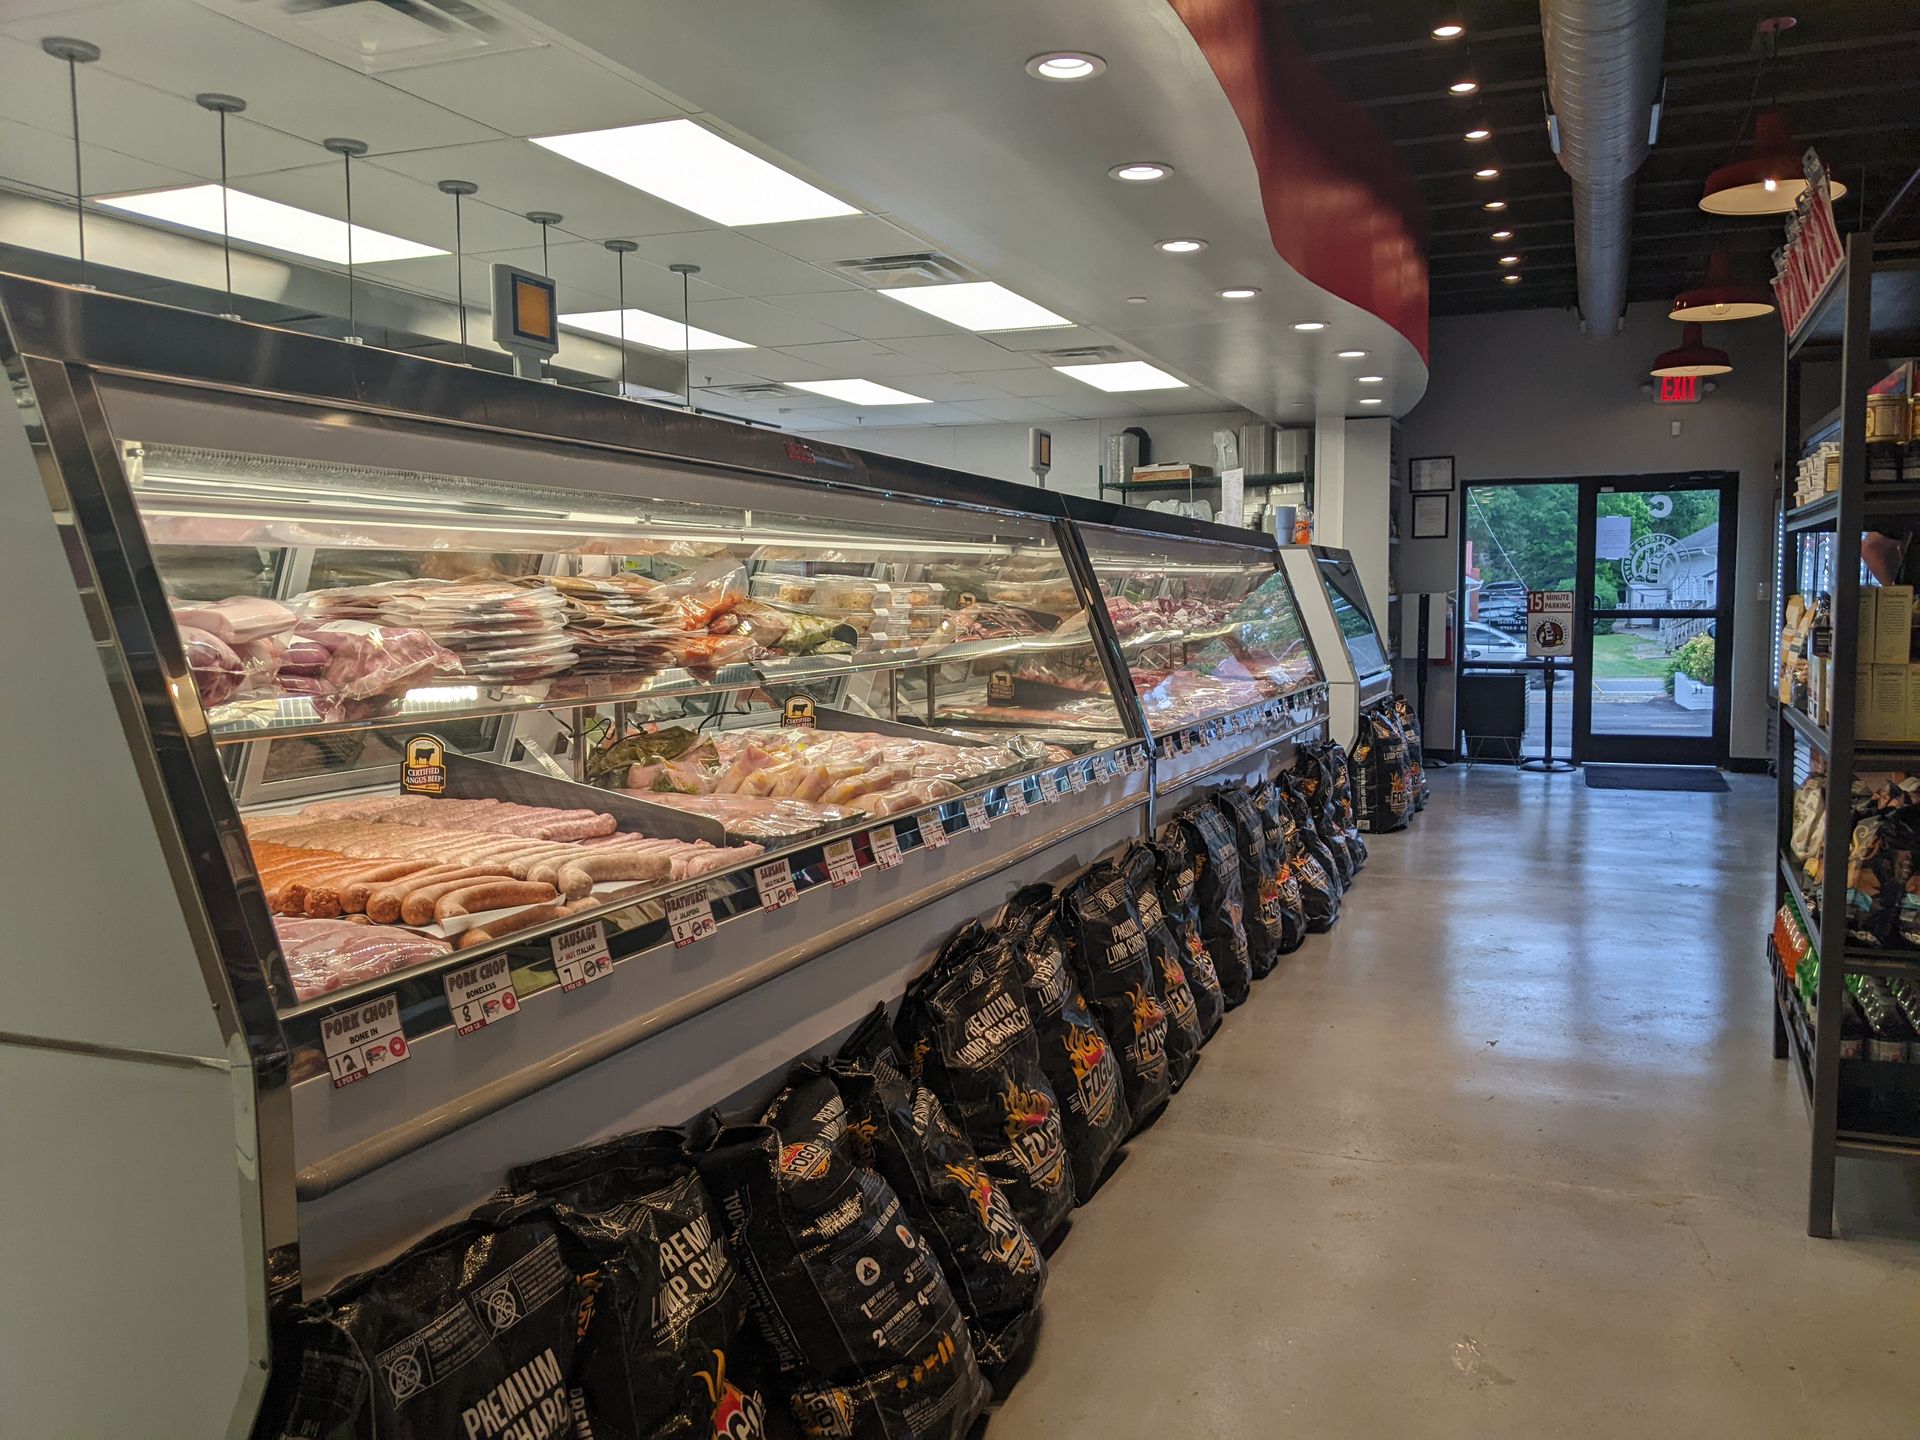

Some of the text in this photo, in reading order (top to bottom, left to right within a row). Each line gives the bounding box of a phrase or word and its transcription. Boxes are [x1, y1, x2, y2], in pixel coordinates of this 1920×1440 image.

[1661, 375, 1697, 401] EXIT
[1528, 593, 1543, 611] 15
[405, 774, 442, 784] ANGUS BEEF
[407, 768, 440, 777] CERTIFIED
[760, 861, 786, 881] SAUSAGE
[666, 889, 708, 914] BRATWURST
[558, 924, 598, 951] SAUSAGE
[575, 943, 596, 957] ITALIAN
[1105, 941, 1129, 965] LUMP
[448, 958, 506, 993] PORK CHOP
[465, 981, 497, 1000] BONELESS
[323, 999, 395, 1040] PORK CHOP
[462, 1004, 472, 1022] 8
[964, 992, 1017, 1041] PREMIUM
[349, 1026, 379, 1045] BONE IN
[955, 1038, 991, 1065] LUMP
[334, 1054, 358, 1077] 12
[1080, 1046, 1115, 1109] FOGO
[786, 1144, 820, 1174] FOGO
[815, 1206, 841, 1227] TASTE
[816, 1205, 864, 1240] DIFFERENCE
[903, 1266, 915, 1284] 3
[917, 1290, 929, 1306] 4
[860, 1302, 873, 1319] 1
[383, 1334, 421, 1362] WARNING
[872, 1329, 887, 1348] 2
[461, 1347, 564, 1440] PREMIUM
